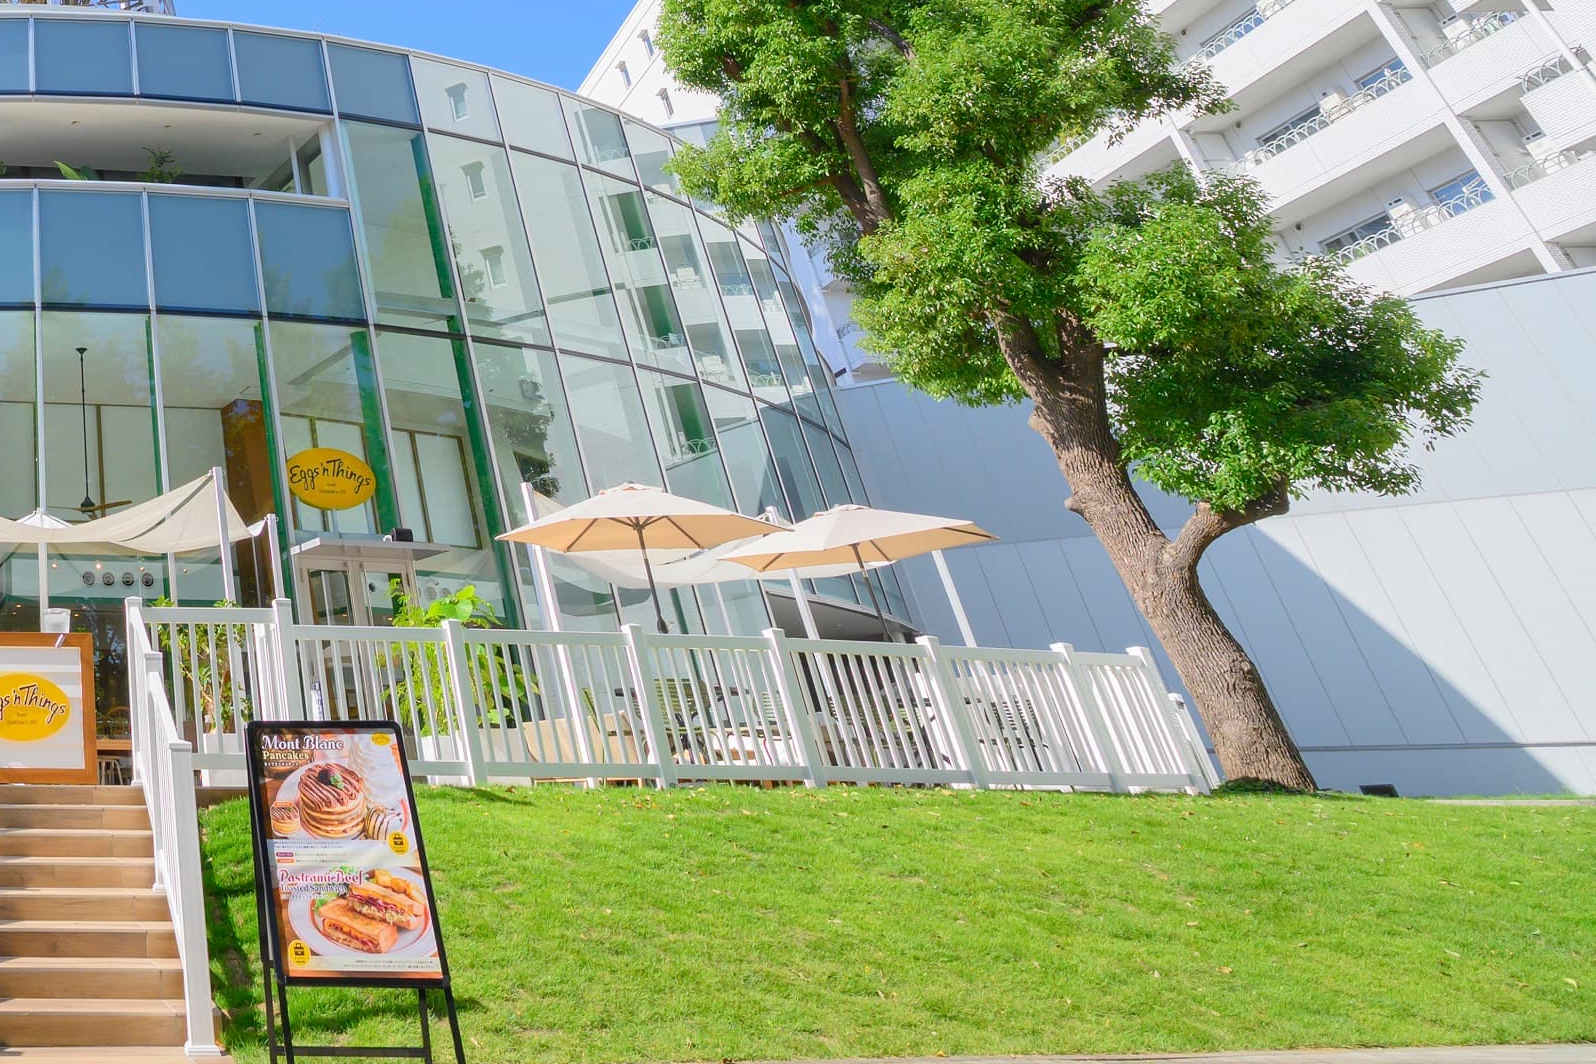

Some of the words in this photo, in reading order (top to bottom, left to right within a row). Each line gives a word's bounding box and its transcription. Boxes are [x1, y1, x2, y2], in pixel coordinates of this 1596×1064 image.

[261, 735, 300, 751] Mont
[302, 735, 344, 751] Blanc
[262, 751, 310, 760] Pancakes
